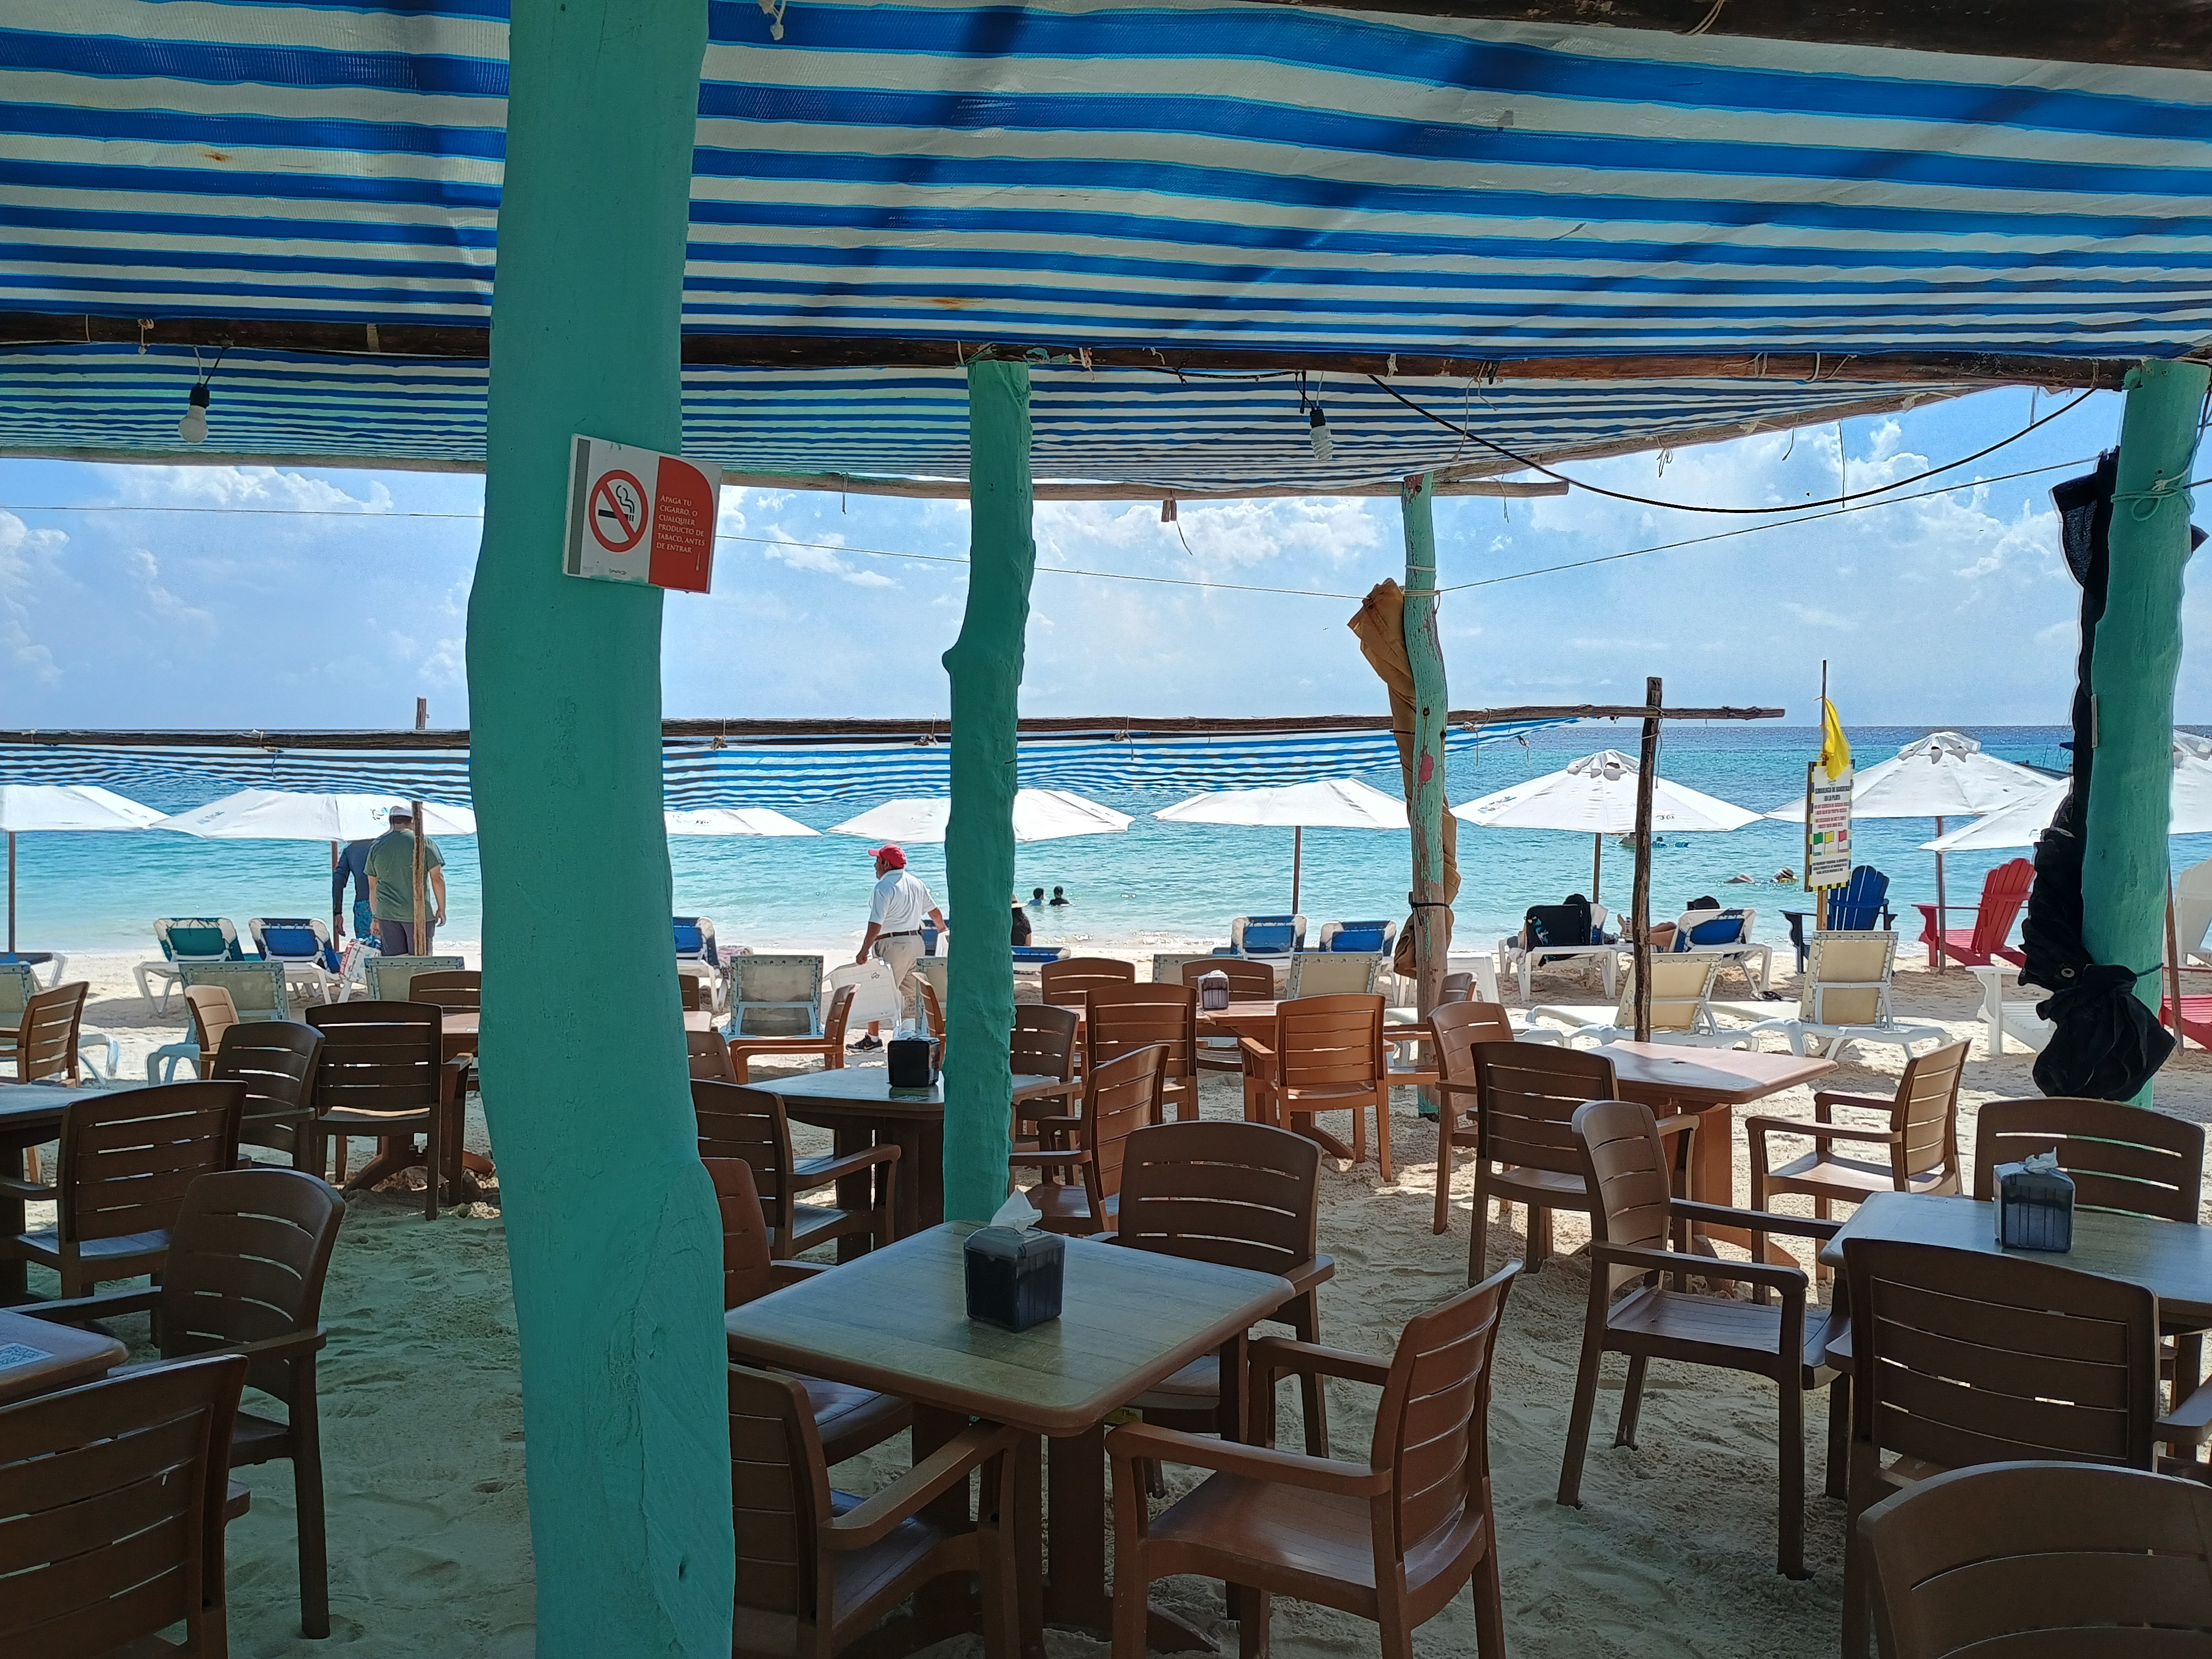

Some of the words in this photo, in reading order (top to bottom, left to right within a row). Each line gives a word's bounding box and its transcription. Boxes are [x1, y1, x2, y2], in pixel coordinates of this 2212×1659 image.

[660, 495, 681, 504] APAGA
[659, 515, 695, 525] CUALQUIER
[658, 523, 694, 535] PRODUCTO
[684, 538, 705, 546] ANTES
[667, 544, 691, 553] ENTRAR
